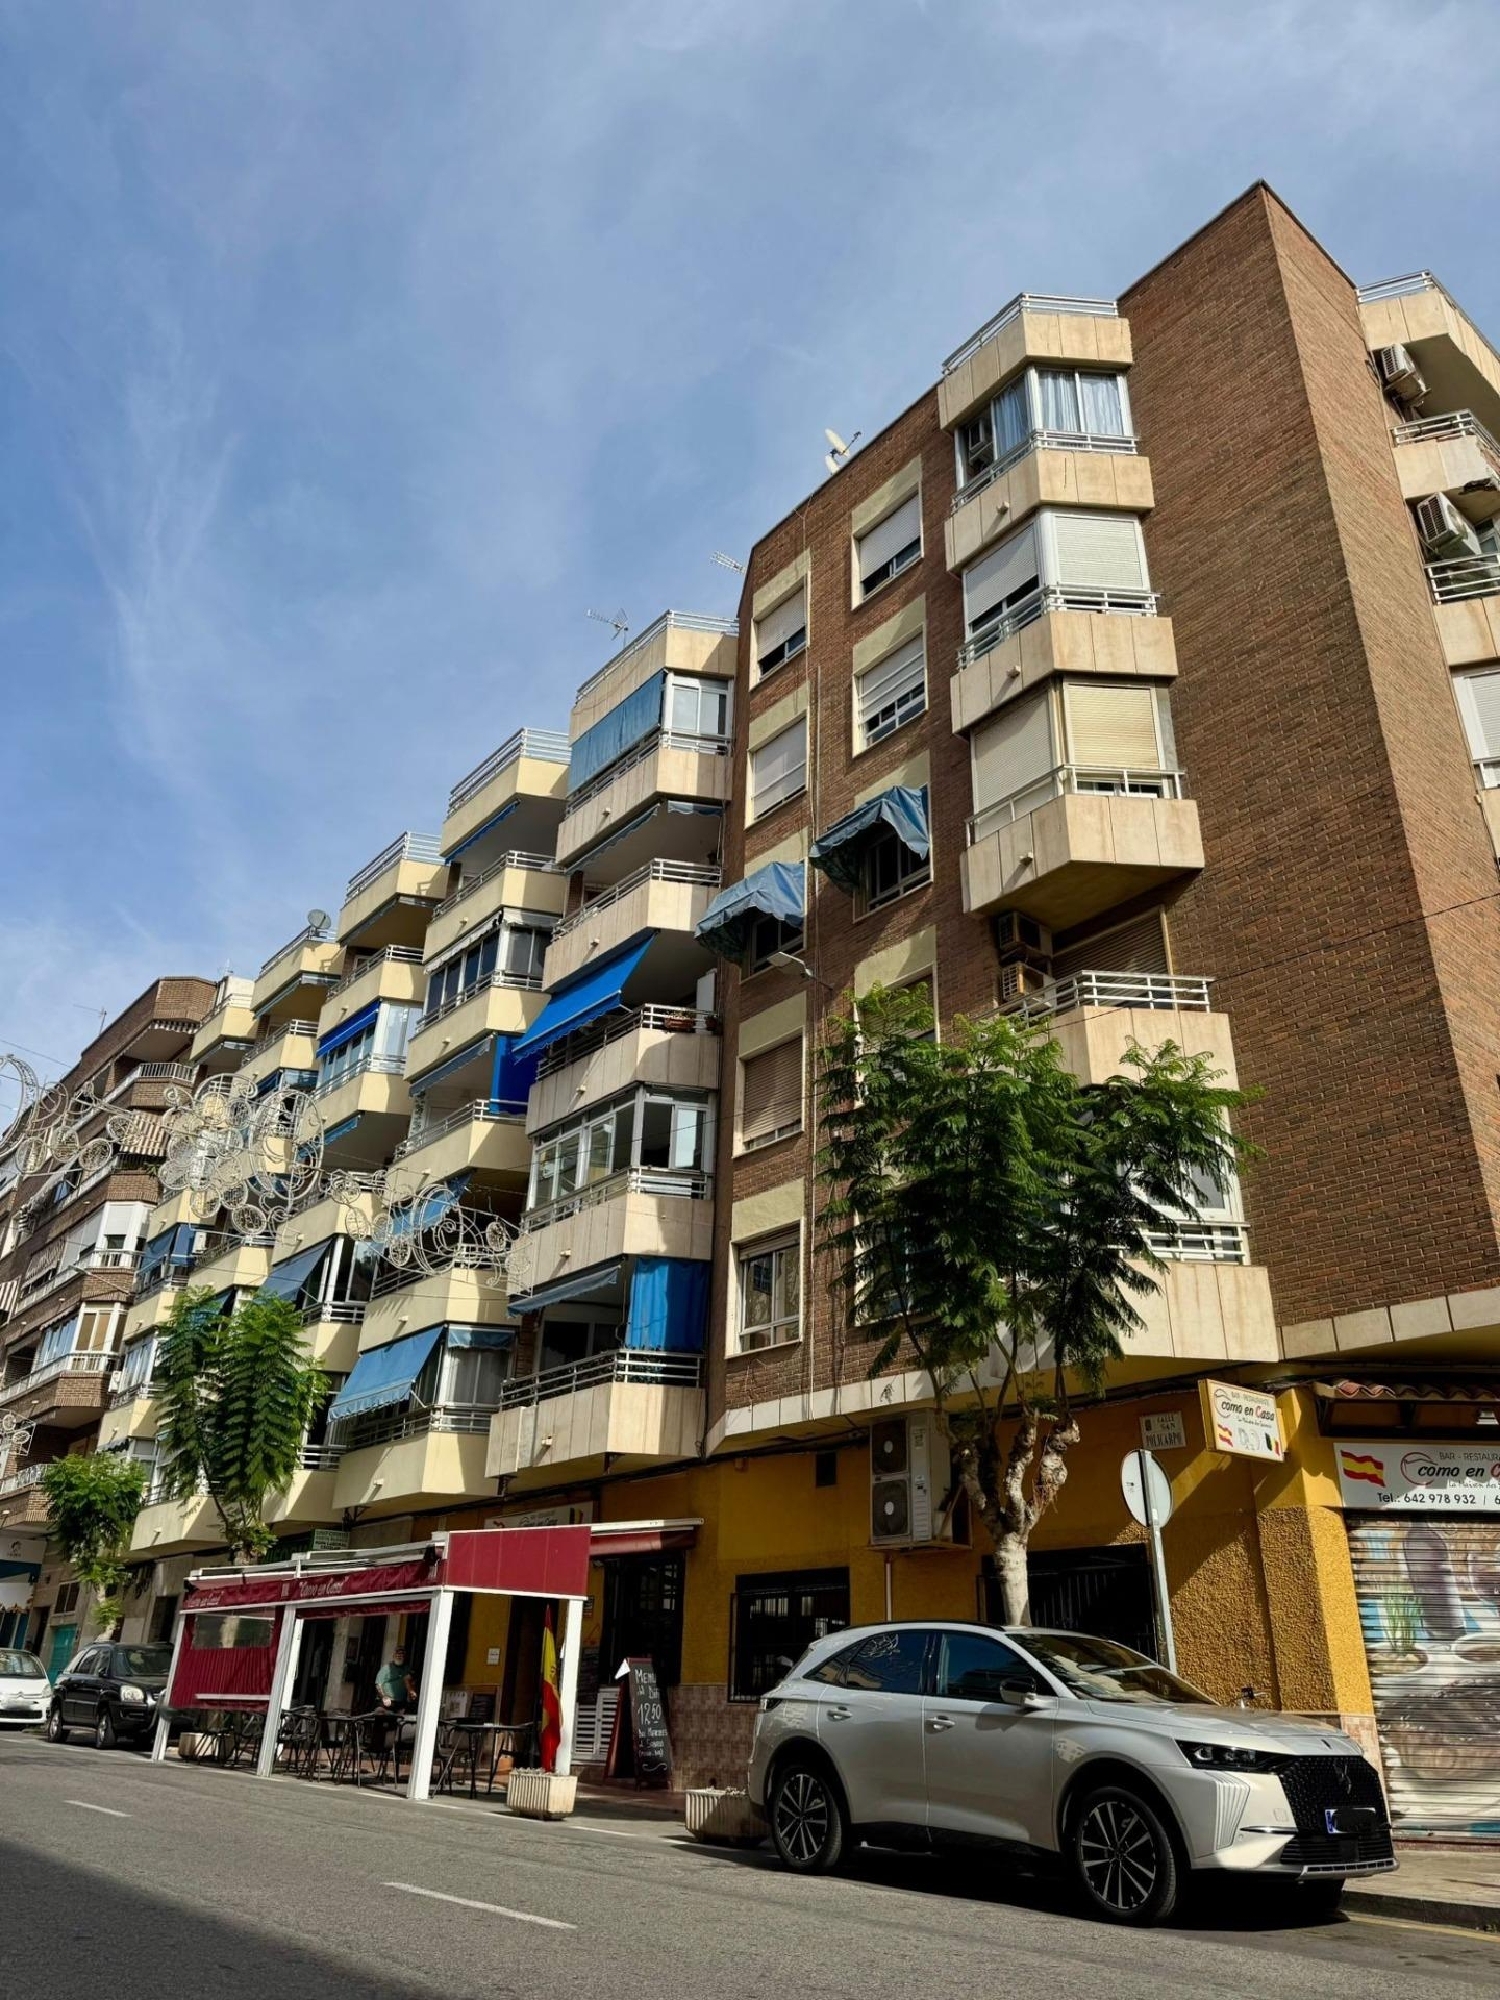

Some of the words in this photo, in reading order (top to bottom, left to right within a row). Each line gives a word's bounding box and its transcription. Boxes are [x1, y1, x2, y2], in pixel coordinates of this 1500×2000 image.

[1244, 1406, 1254, 1416] en
[1255, 1405, 1275, 1421] Casa
[1439, 1452, 1455, 1460] BAR
[1418, 1466, 1460, 1477] como
[1466, 1467, 1485, 1477] en
[1404, 1494, 1426, 1503] 642
[1429, 1494, 1450, 1504] 978
[1454, 1495, 1476, 1504] 932
